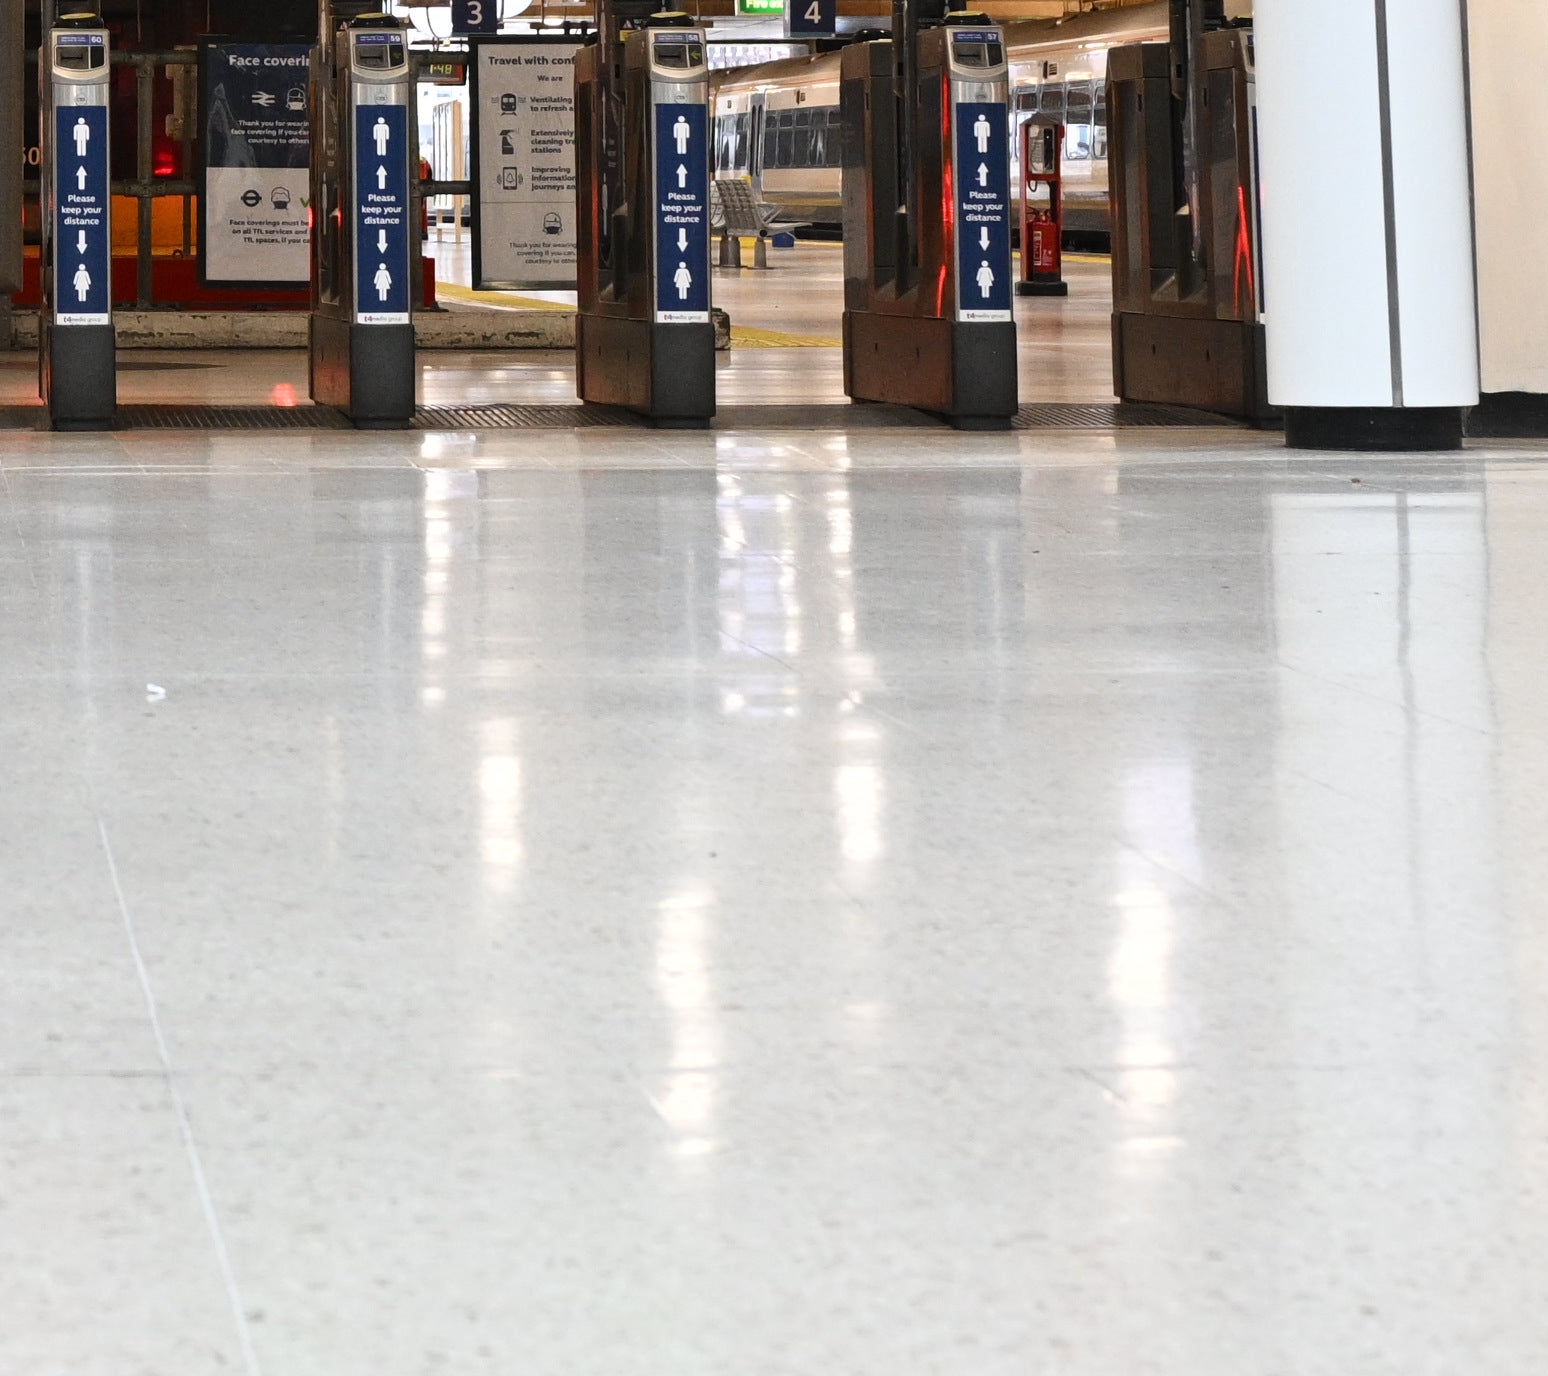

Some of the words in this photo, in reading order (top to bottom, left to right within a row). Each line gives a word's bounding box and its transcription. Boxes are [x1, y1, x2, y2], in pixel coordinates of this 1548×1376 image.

[768, 0, 784, 10] ex
[466, 0, 483, 25] 3
[804, 0, 822, 24] 4
[228, 54, 261, 66] Face
[263, 54, 310, 66] coveri
[488, 55, 522, 65] Travel
[524, 55, 549, 65] with
